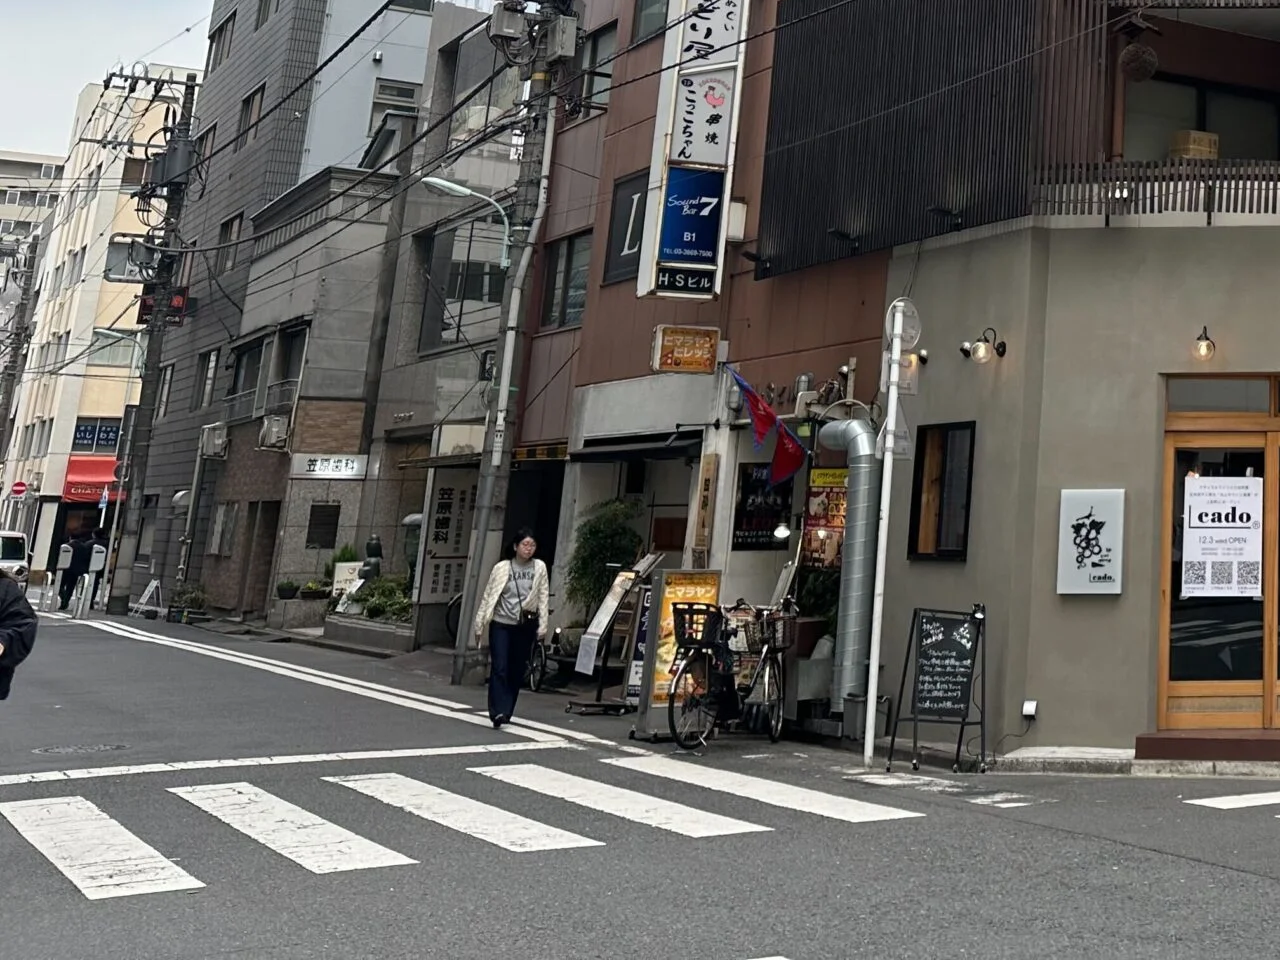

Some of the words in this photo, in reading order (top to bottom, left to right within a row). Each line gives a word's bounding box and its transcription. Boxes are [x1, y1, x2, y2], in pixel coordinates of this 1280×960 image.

[677, 89, 697, 159] こっこちゃん
[704, 113, 723, 145] 串焼
[667, 194, 700, 207] Sound
[699, 196, 719, 216] 7
[681, 205, 698, 215] Bar
[683, 231, 696, 242] B1
[306, 458, 355, 472] 笠原歯科
[432, 487, 455, 544] 笠原歯科
[1197, 506, 1252, 524] cado
[1228, 536, 1247, 544] OPEN
[1092, 573, 1112, 581] cado
[664, 586, 716, 597] ヒマラヤン
